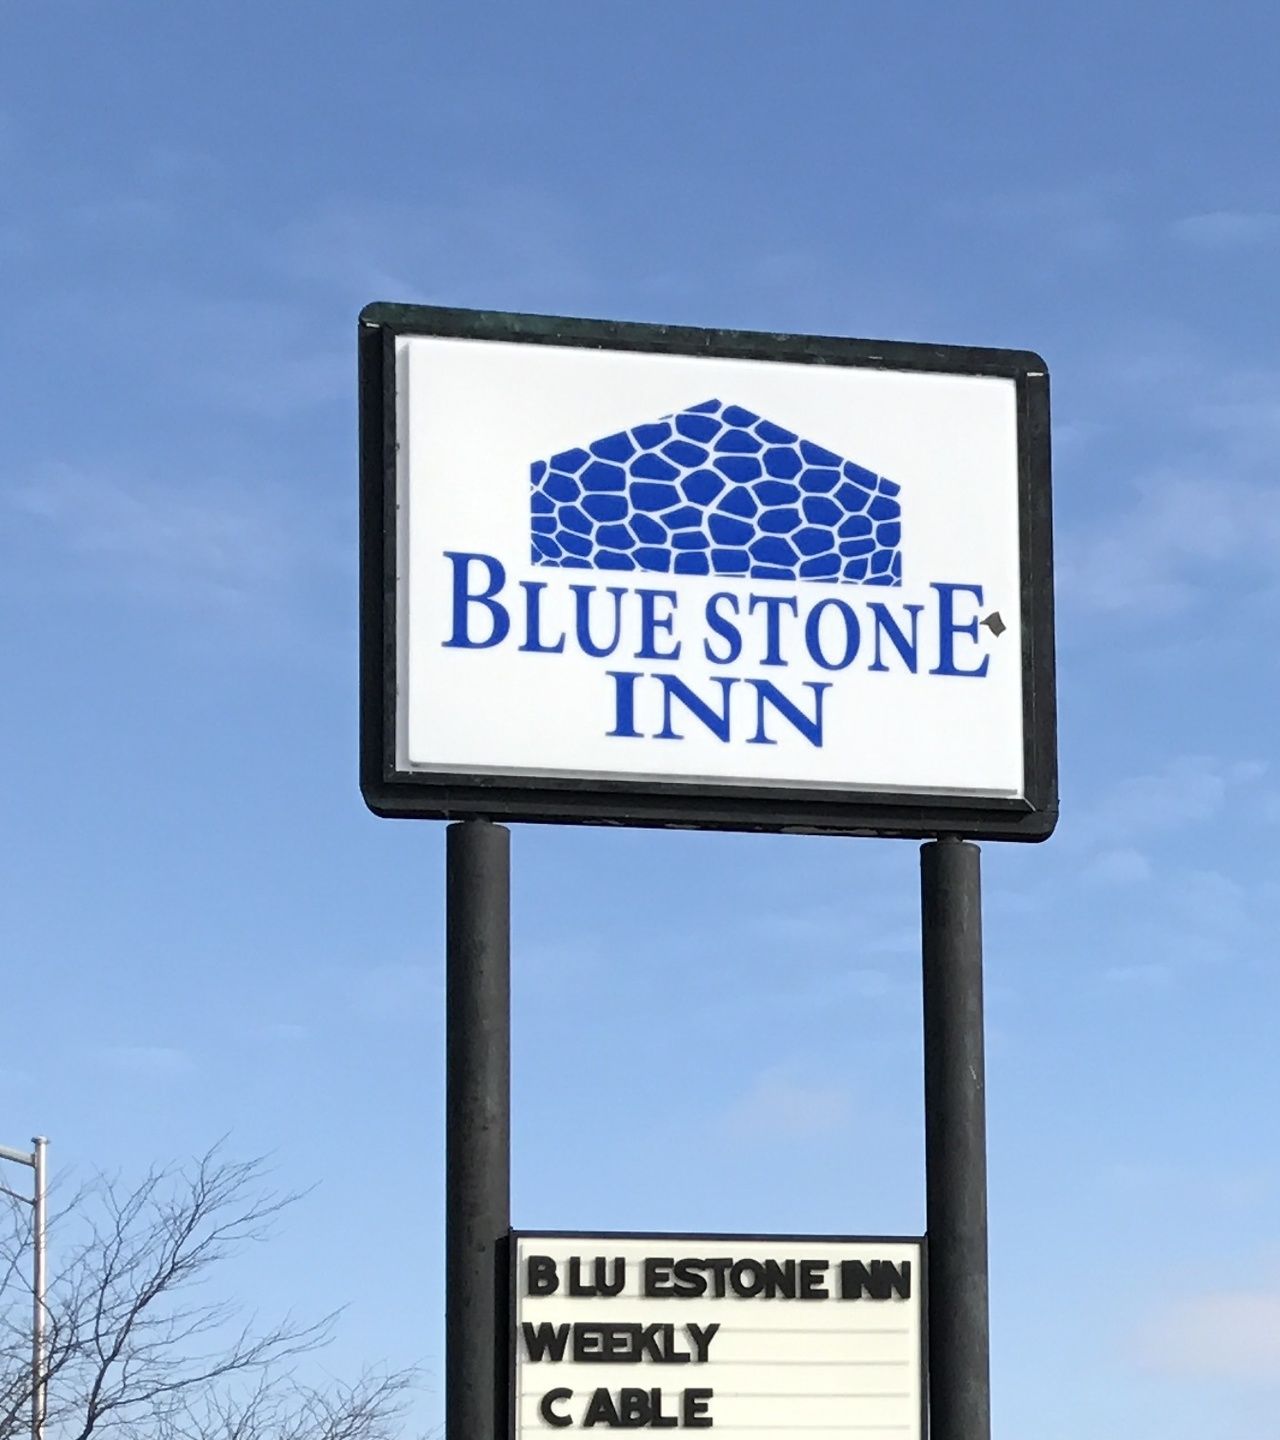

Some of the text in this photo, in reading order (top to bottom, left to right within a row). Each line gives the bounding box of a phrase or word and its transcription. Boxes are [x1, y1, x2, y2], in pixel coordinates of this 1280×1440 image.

[441, 550, 990, 678] BLUE STONE
[605, 671, 833, 748] INN
[522, 1321, 720, 1363] WEEKLY
